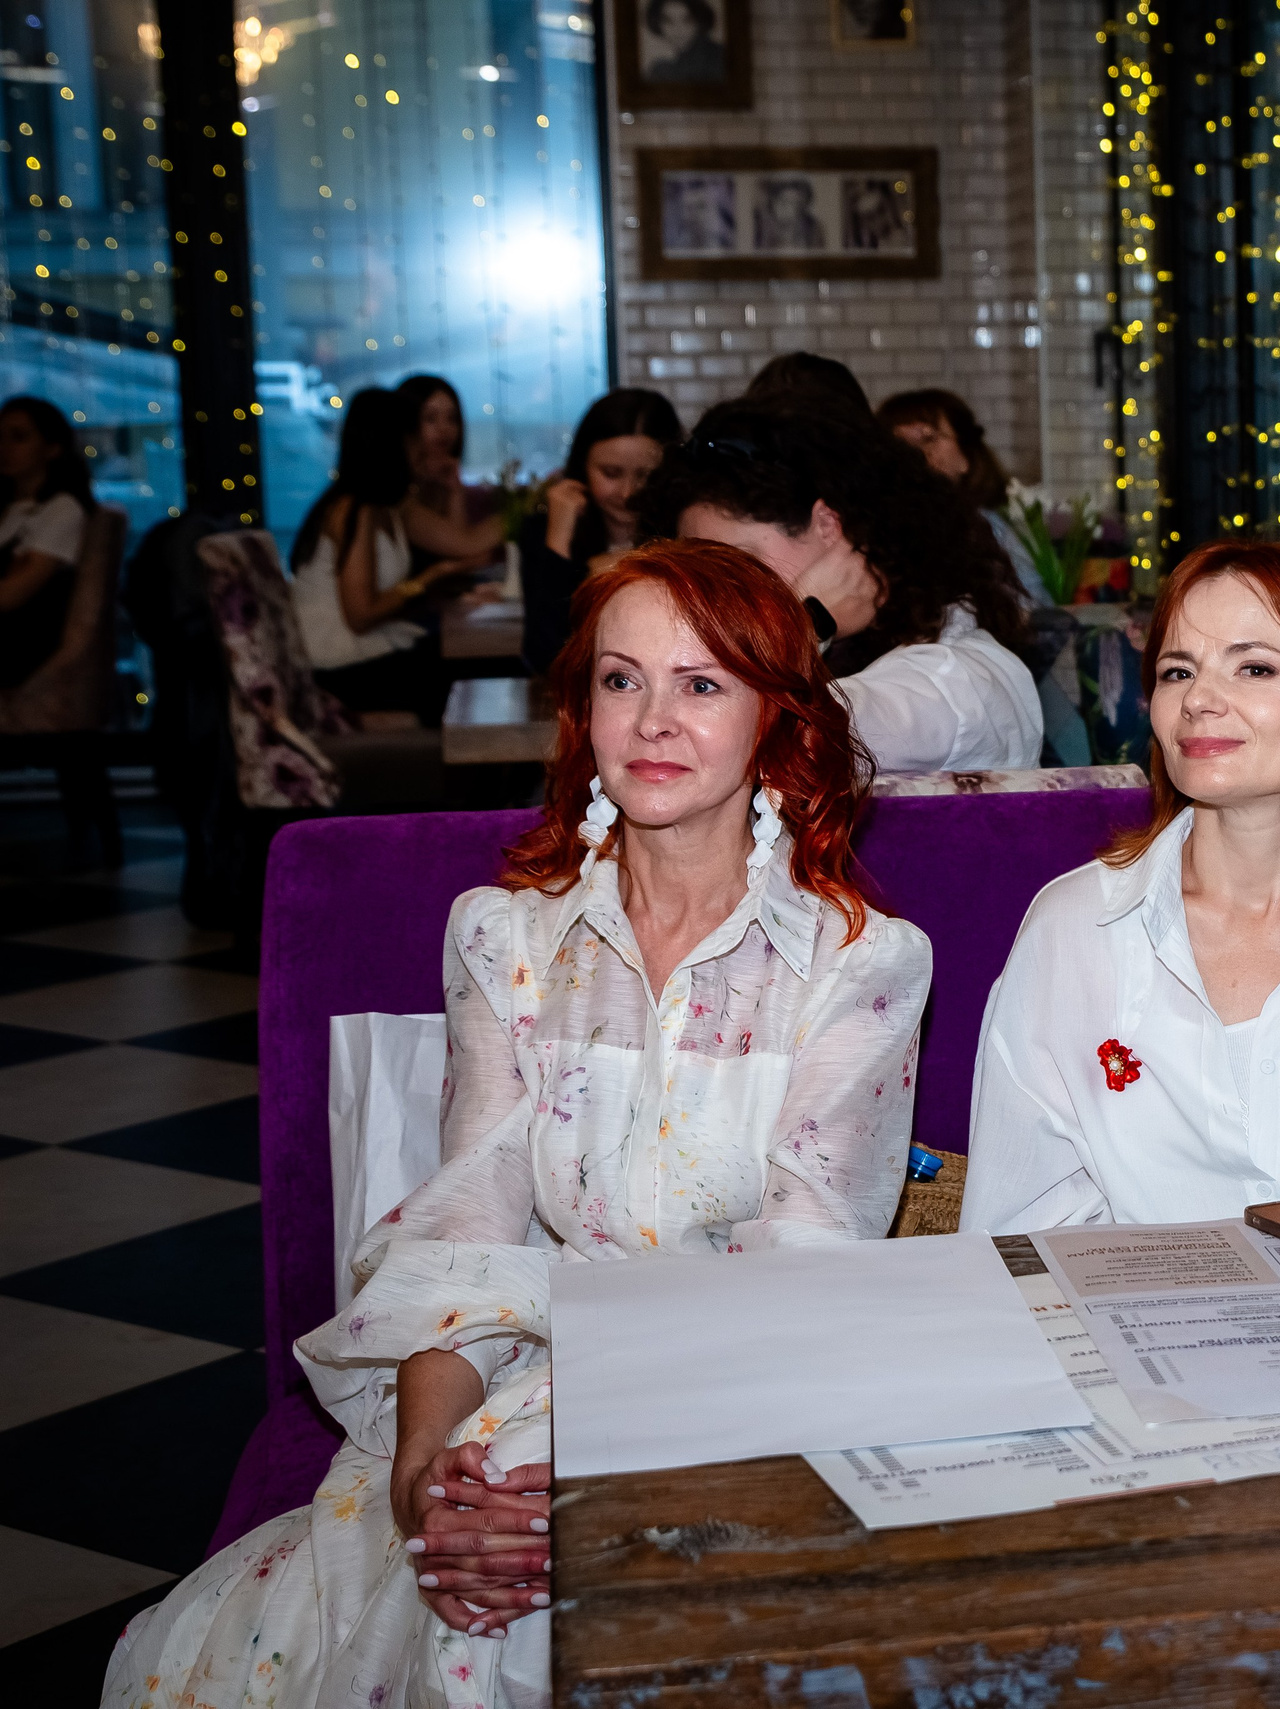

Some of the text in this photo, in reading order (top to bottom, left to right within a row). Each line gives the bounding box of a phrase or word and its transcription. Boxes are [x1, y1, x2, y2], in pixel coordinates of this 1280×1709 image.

[1118, 1320, 1181, 1329] НАПИТКИ
[1132, 1445, 1206, 1461] КОКТЕЙЛИ
[1057, 1462, 1091, 1473] РОМ
[1089, 1471, 1149, 1483] SEVEN
